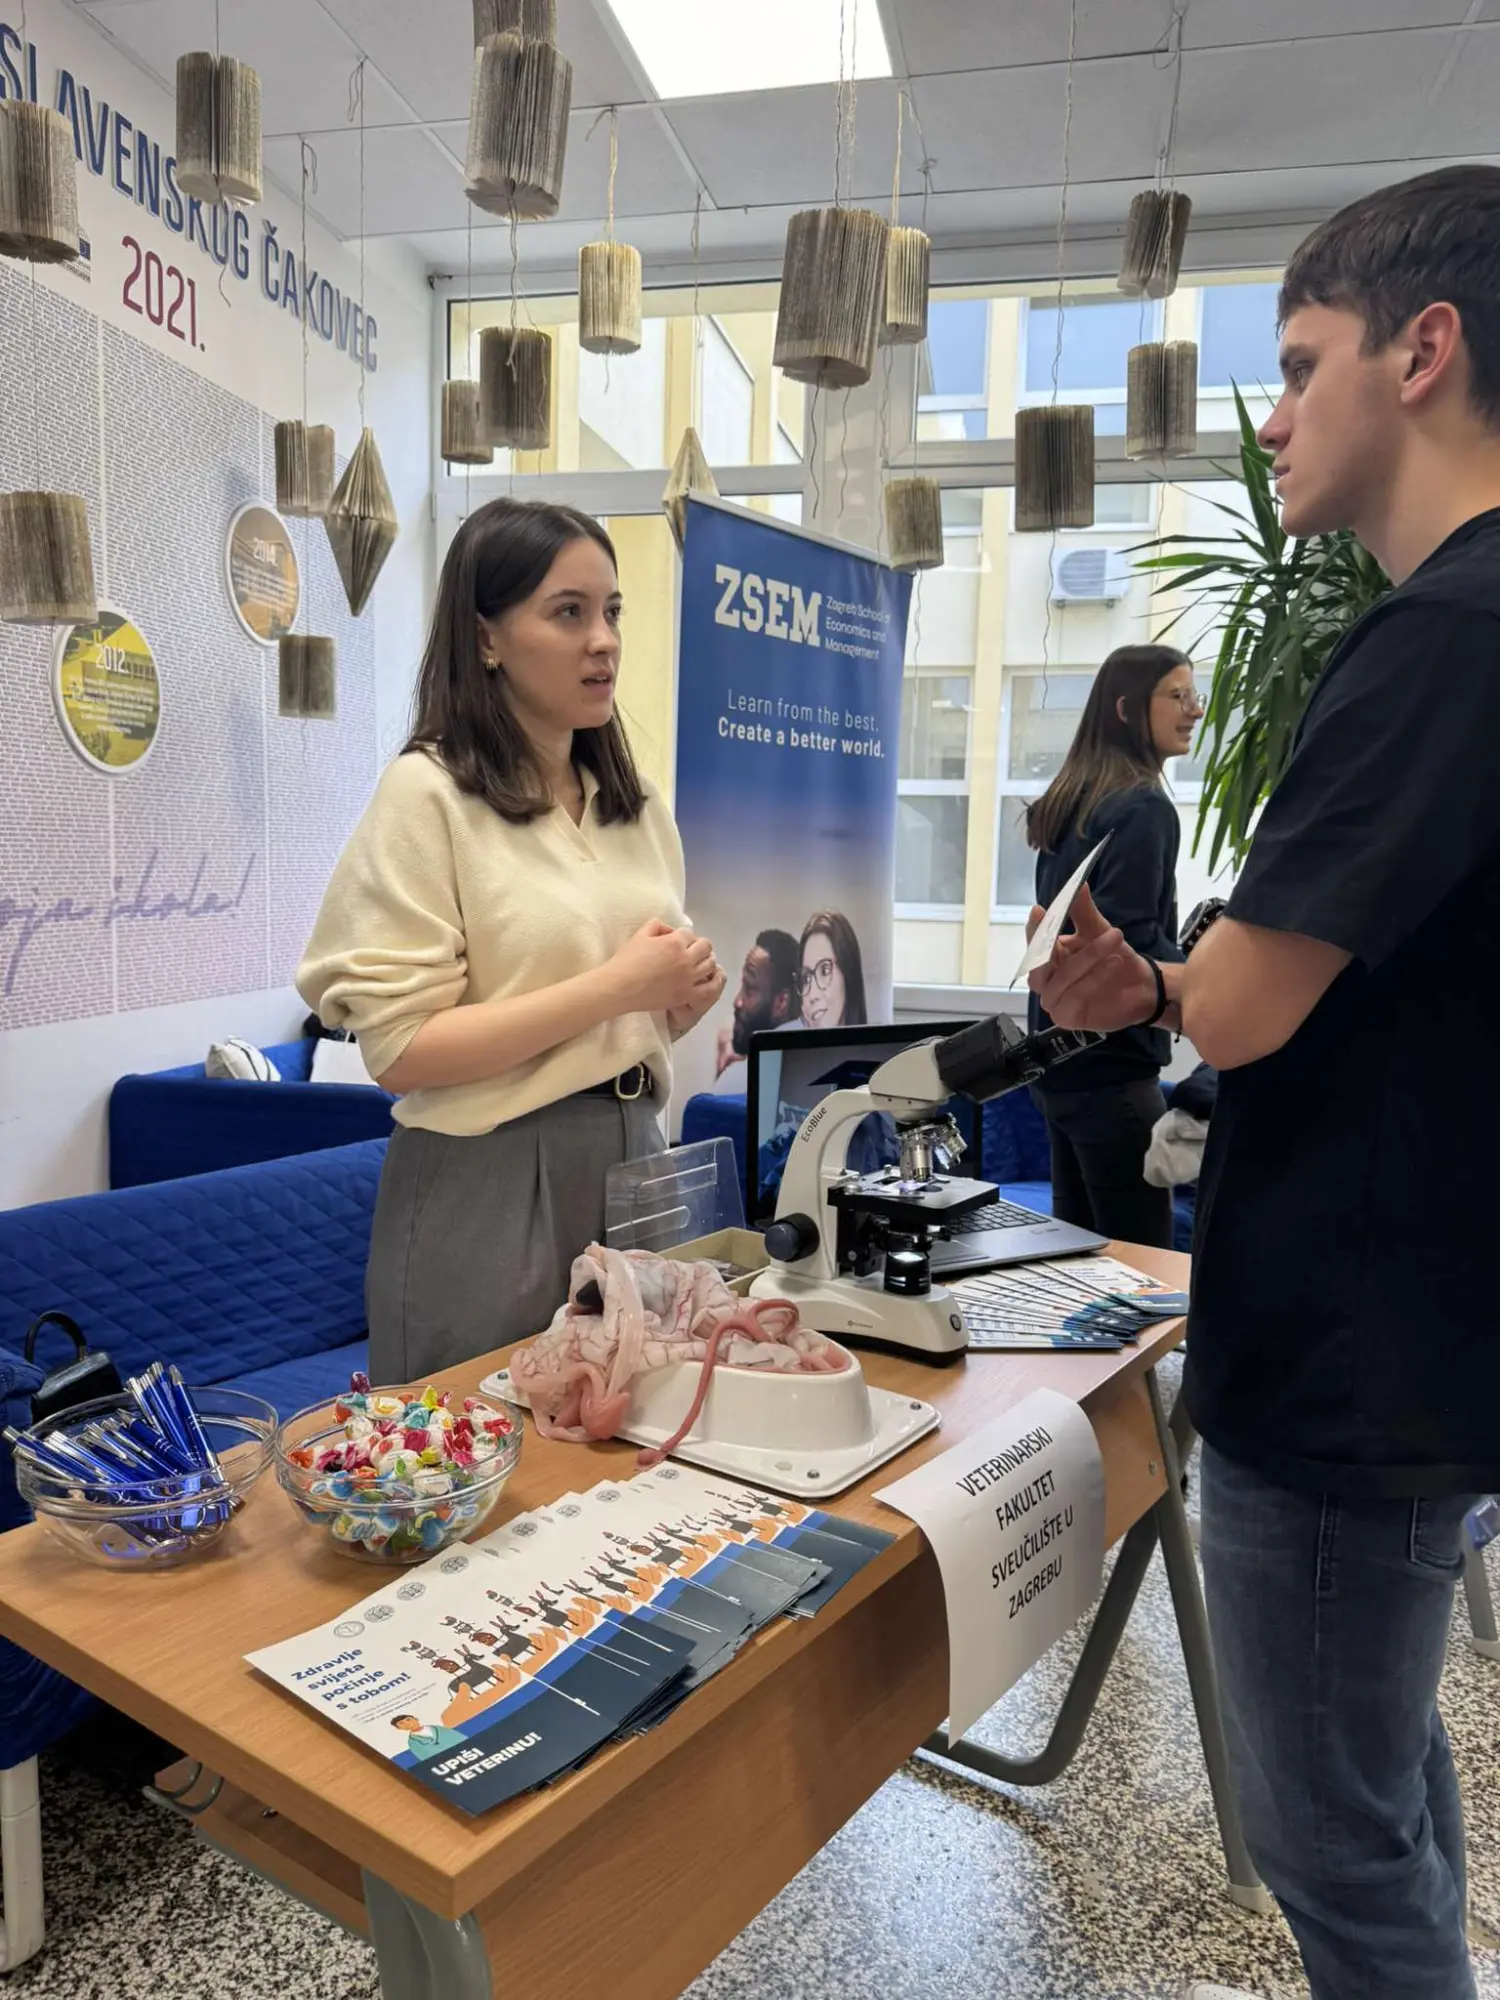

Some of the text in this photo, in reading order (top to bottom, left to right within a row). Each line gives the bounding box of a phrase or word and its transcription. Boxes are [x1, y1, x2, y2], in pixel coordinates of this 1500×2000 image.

[122, 235, 205, 352] 2021.
[263, 219, 378, 373] ČAKOVEC
[715, 564, 822, 647] ZSEM
[827, 596, 857, 616] Zagreb
[858, 604, 884, 622] School
[825, 637, 880, 660] Management
[826, 616, 886, 643] Economics and
[96, 643, 129, 673] 2012.
[728, 689, 879, 732] Learn from the best.
[718, 716, 885, 759] Create a better world.
[801, 1107, 828, 1143] EcoBlue
[956, 1426, 1053, 1497] VETERINARSKI
[995, 1469, 1056, 1531] FAKULTET
[992, 1504, 1074, 1589] SVEUČILIŠTE U
[1009, 1554, 1063, 1620] ZAGREBU
[291, 1648, 363, 1680] Zdravlje
[308, 1663, 365, 1690] svijeta
[322, 1670, 384, 1701] počinje
[336, 1702, 348, 1710] s
[349, 1672, 411, 1704] tobom!
[431, 1747, 485, 1776] UPIŠI
[444, 1731, 543, 1786] VETERINU!
